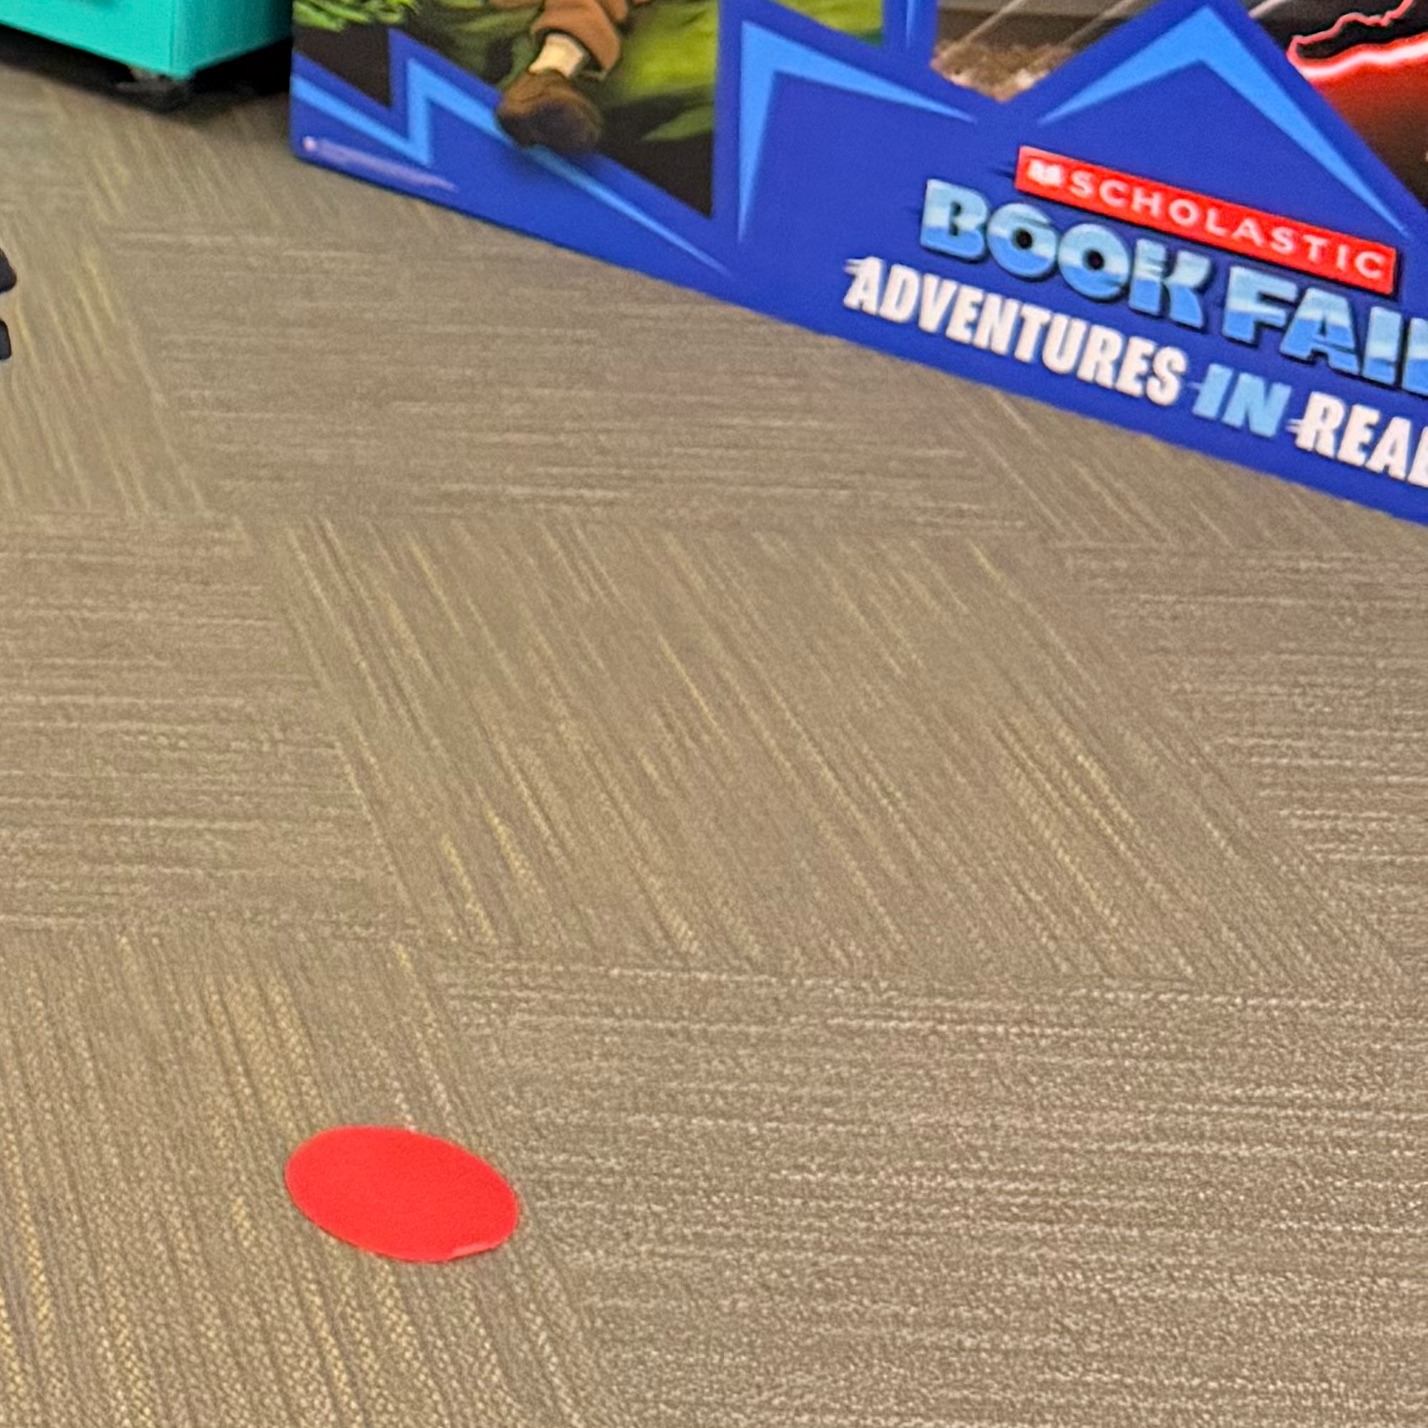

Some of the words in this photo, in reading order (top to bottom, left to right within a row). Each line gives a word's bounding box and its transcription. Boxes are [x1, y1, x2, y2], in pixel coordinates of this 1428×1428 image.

[920, 179, 1212, 328] BOOK
[1071, 169, 1387, 280] SCHOLASTIC
[844, 256, 1188, 408] ADVENTURES
[1191, 363, 1292, 438] IN
